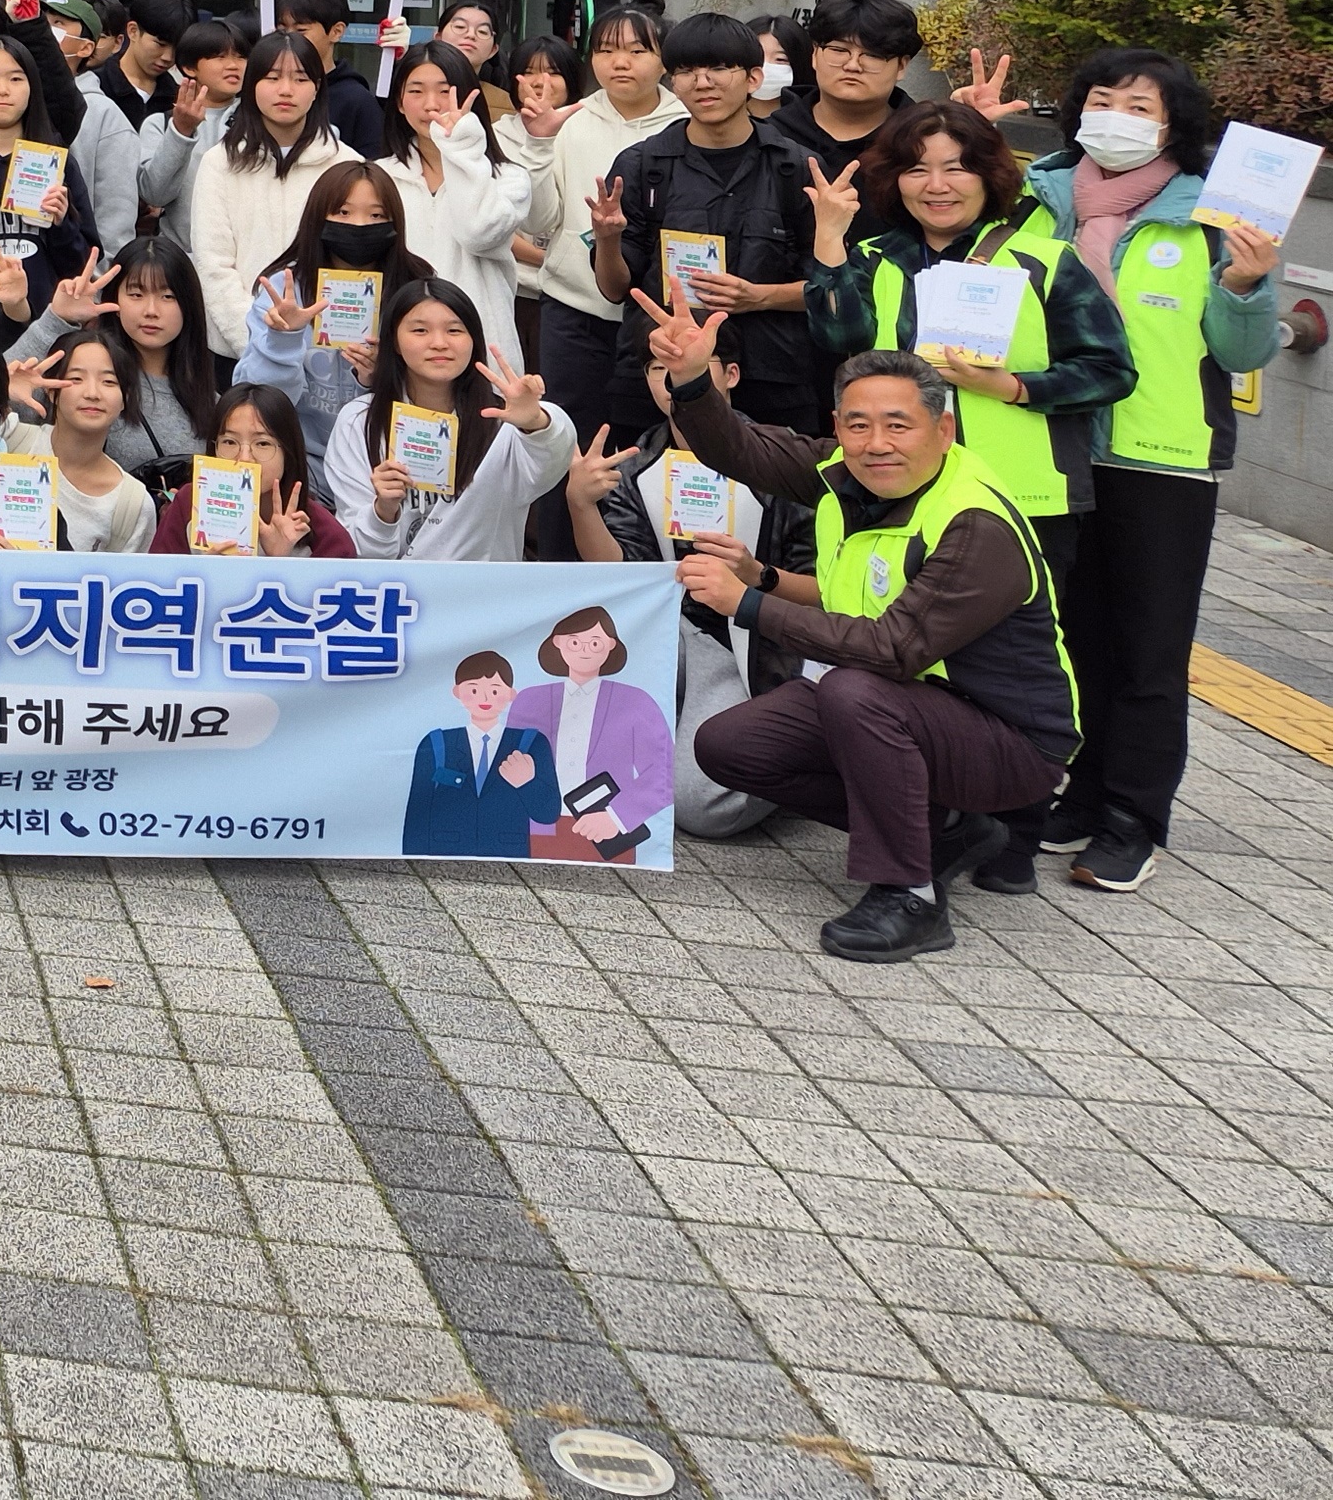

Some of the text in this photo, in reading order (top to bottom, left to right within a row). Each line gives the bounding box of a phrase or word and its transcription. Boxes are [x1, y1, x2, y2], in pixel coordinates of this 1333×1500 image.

[13, 580, 199, 672] 지역
[219, 587, 412, 676] 순찰
[82, 702, 230, 746] 주세요
[30, 769, 58, 791] 앞
[63, 767, 119, 792] 광장
[99, 812, 325, 840] 032-749-6791
